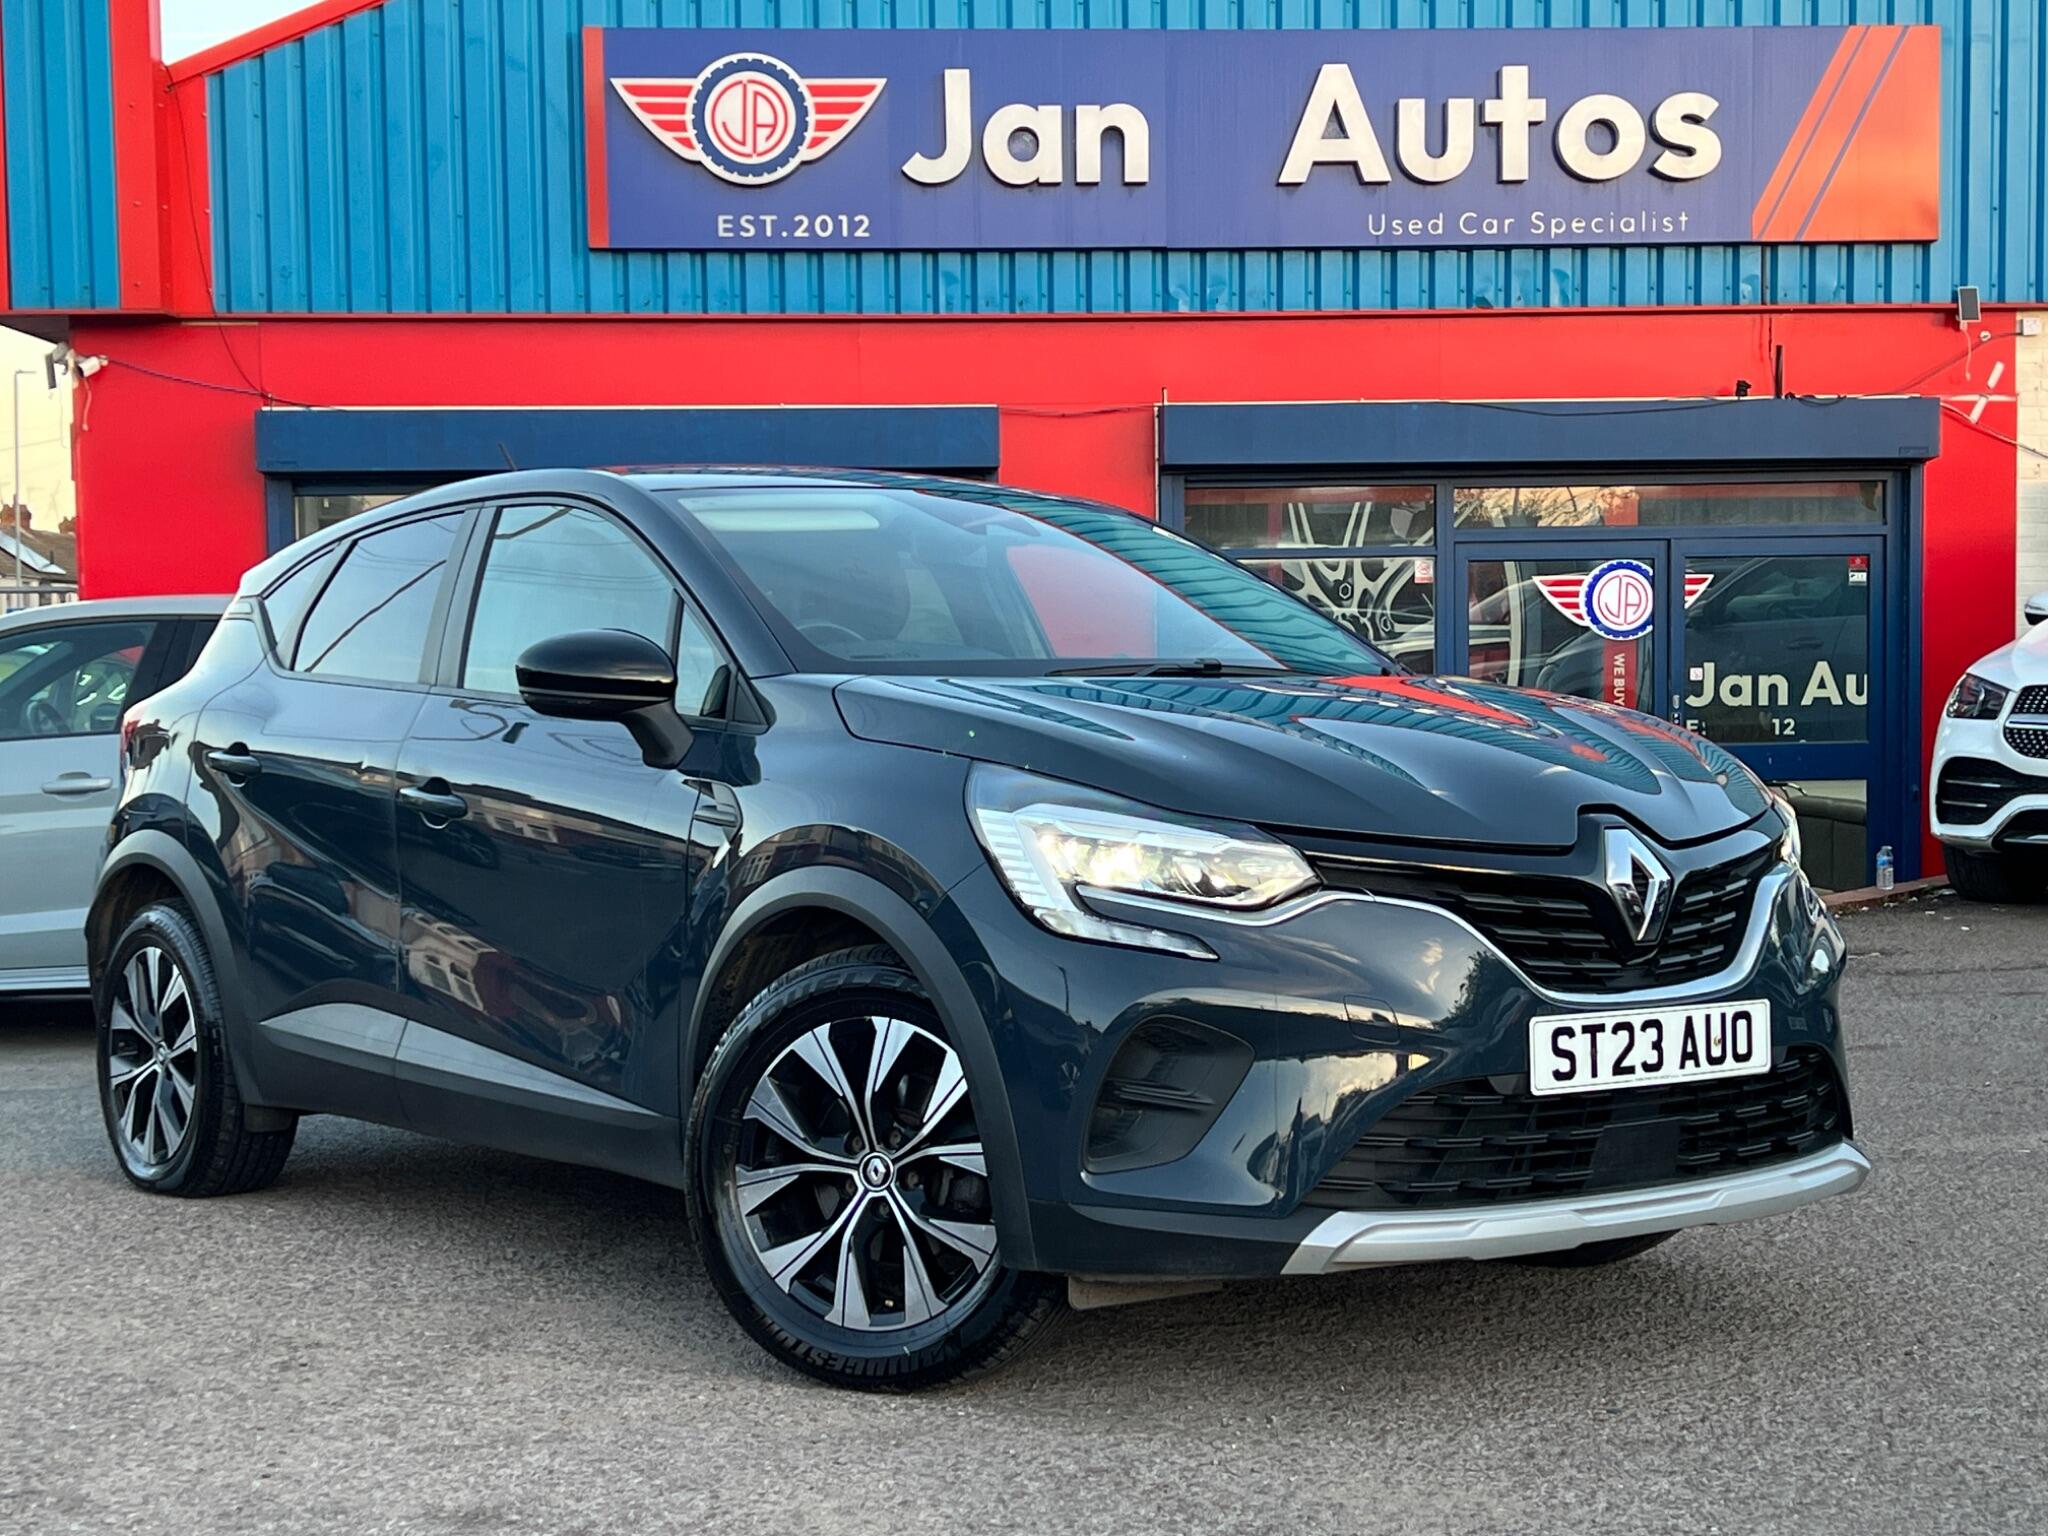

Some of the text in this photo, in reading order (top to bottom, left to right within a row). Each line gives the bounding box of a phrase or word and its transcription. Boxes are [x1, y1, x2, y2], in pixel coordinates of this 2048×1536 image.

[901, 63, 1722, 186] Jan Autos
[717, 214, 871, 239] EST.2012
[1367, 210, 1690, 238] Used Car Specialist
[1613, 653, 1626, 706] WE BUY
[1685, 661, 1789, 708] Jan
[1771, 718, 1796, 736] 12
[1551, 1010, 1753, 1082] ST23 AUO
